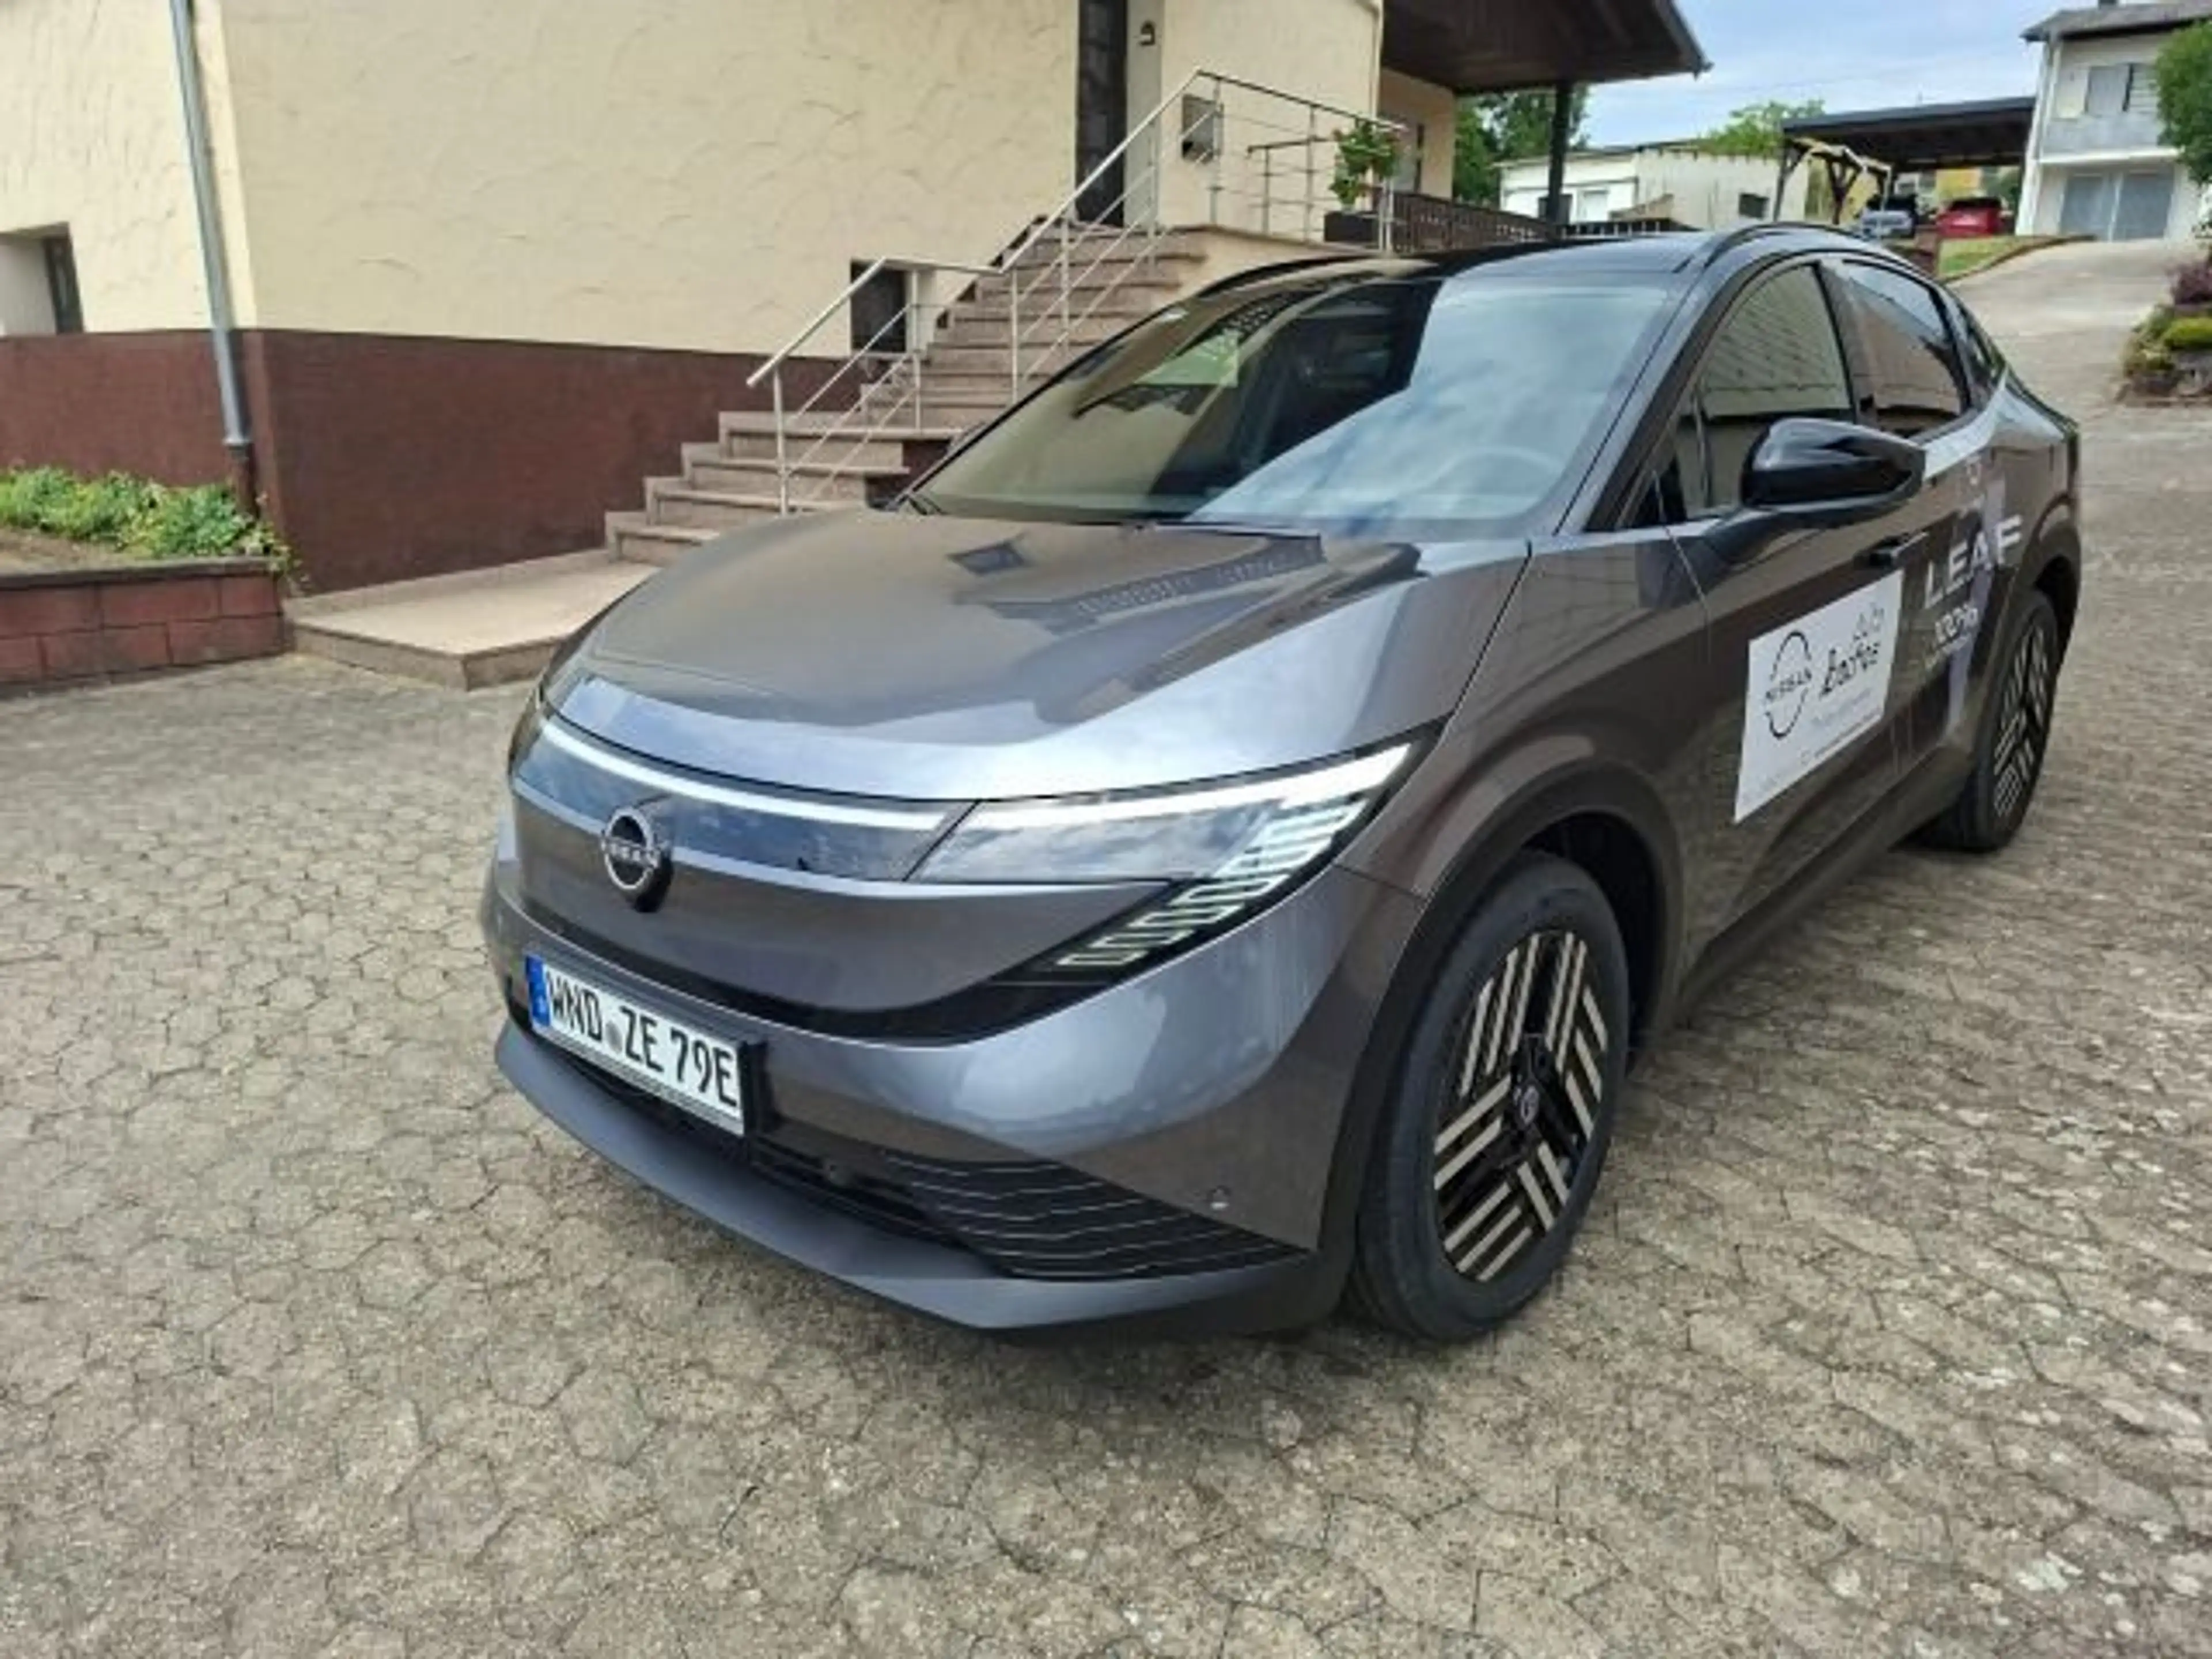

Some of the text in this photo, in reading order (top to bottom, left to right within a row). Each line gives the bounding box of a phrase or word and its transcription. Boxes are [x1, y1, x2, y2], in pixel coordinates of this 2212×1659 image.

[1925, 514, 2022, 609] LEAF
[546, 971, 737, 1107] WND ZE 79E
